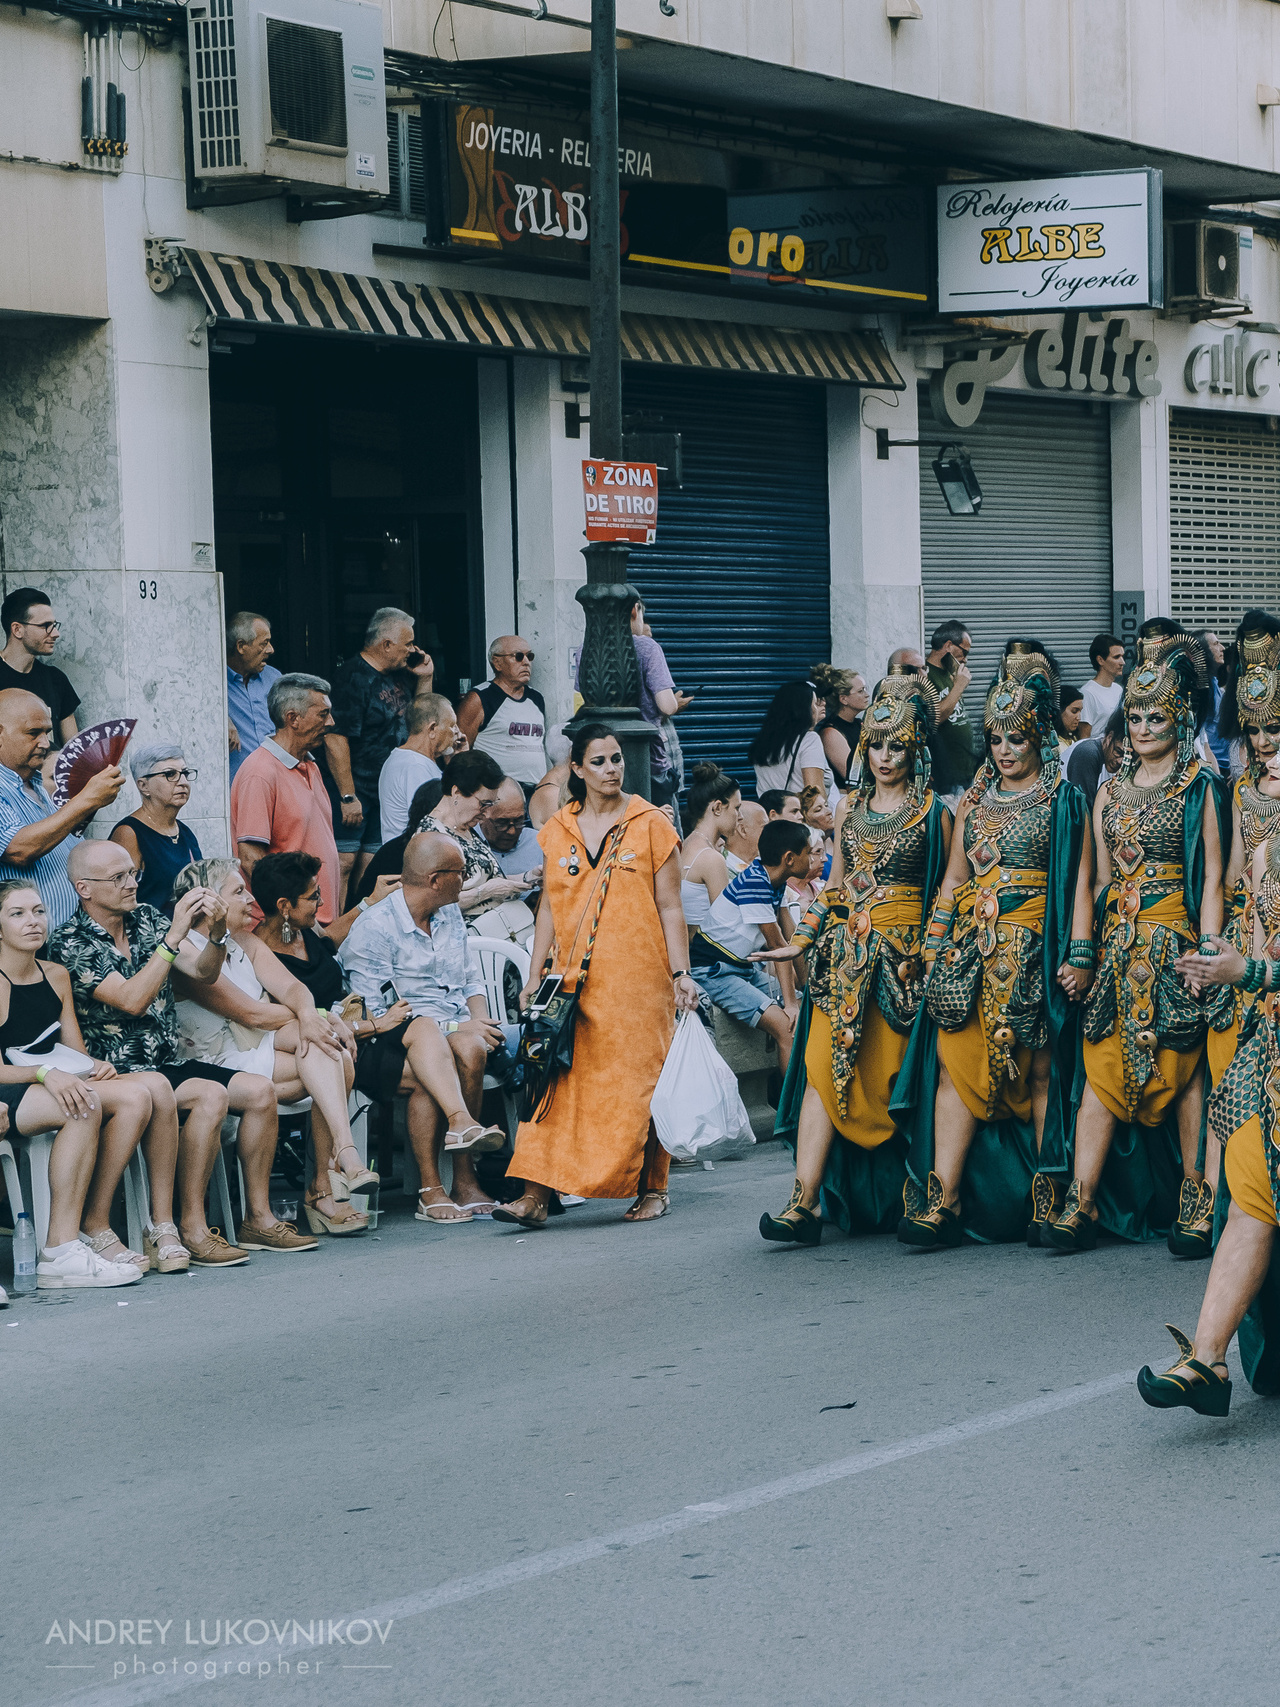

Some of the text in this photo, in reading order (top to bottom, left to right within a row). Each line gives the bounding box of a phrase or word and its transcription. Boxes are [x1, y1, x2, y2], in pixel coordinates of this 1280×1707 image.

[465, 121, 542, 160] JOYERIA
[561, 137, 653, 178] RELERIA
[514, 183, 593, 241] ALB
[945, 189, 1071, 226] Relojería
[728, 226, 806, 272] oro
[980, 222, 1105, 264] ALBE
[1022, 262, 1140, 301] Joyería
[602, 466, 654, 488] ZONA
[585, 493, 656, 515] DE TIRO
[139, 580, 158, 600] 93
